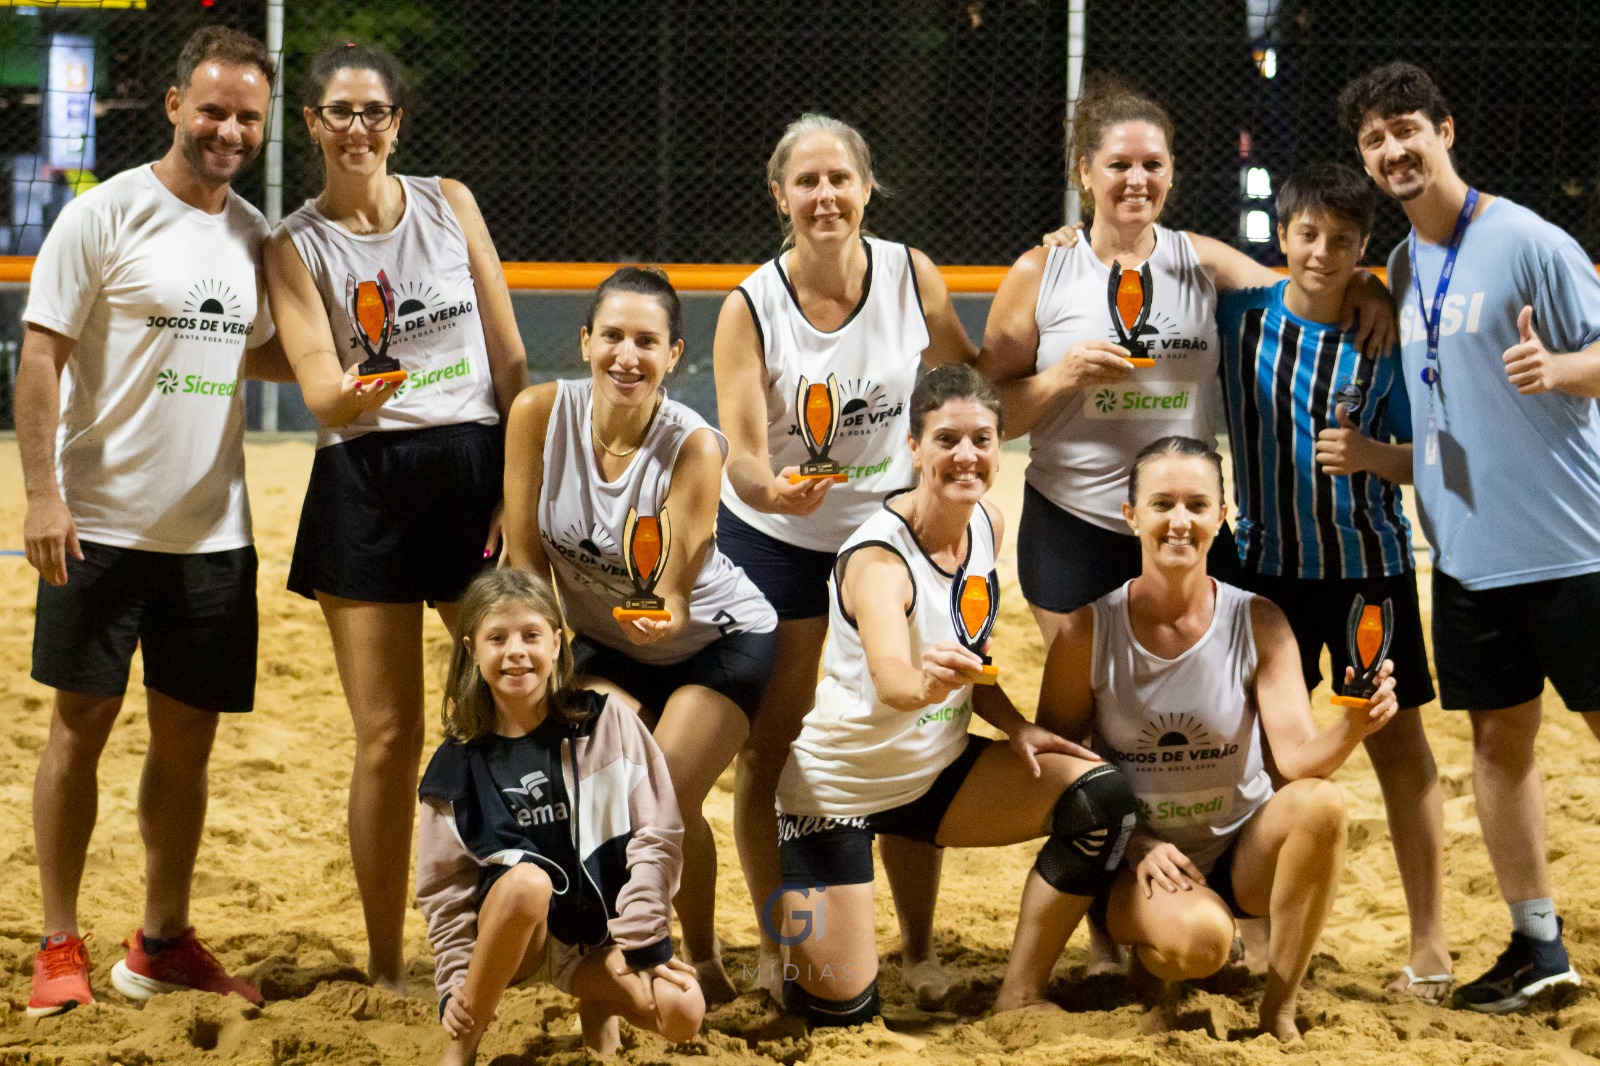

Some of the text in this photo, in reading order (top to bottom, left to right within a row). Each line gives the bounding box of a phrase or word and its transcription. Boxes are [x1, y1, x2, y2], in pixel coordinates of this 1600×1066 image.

[146, 316, 197, 330] JOGOS
[199, 319, 219, 332] DE
[405, 301, 473, 333] DE VERÃO
[174, 333, 199, 341] SANTA
[412, 329, 434, 340] ROSA
[1160, 337, 1208, 351] VERÃO
[409, 357, 471, 389] Sicredi
[1121, 390, 1190, 410] Sicredi
[843, 414, 864, 427] DE
[1161, 751, 1184, 762] DE
[1189, 744, 1238, 761] VERÃO
[511, 802, 569, 827] ema
[1156, 796, 1224, 819] Sicredi
